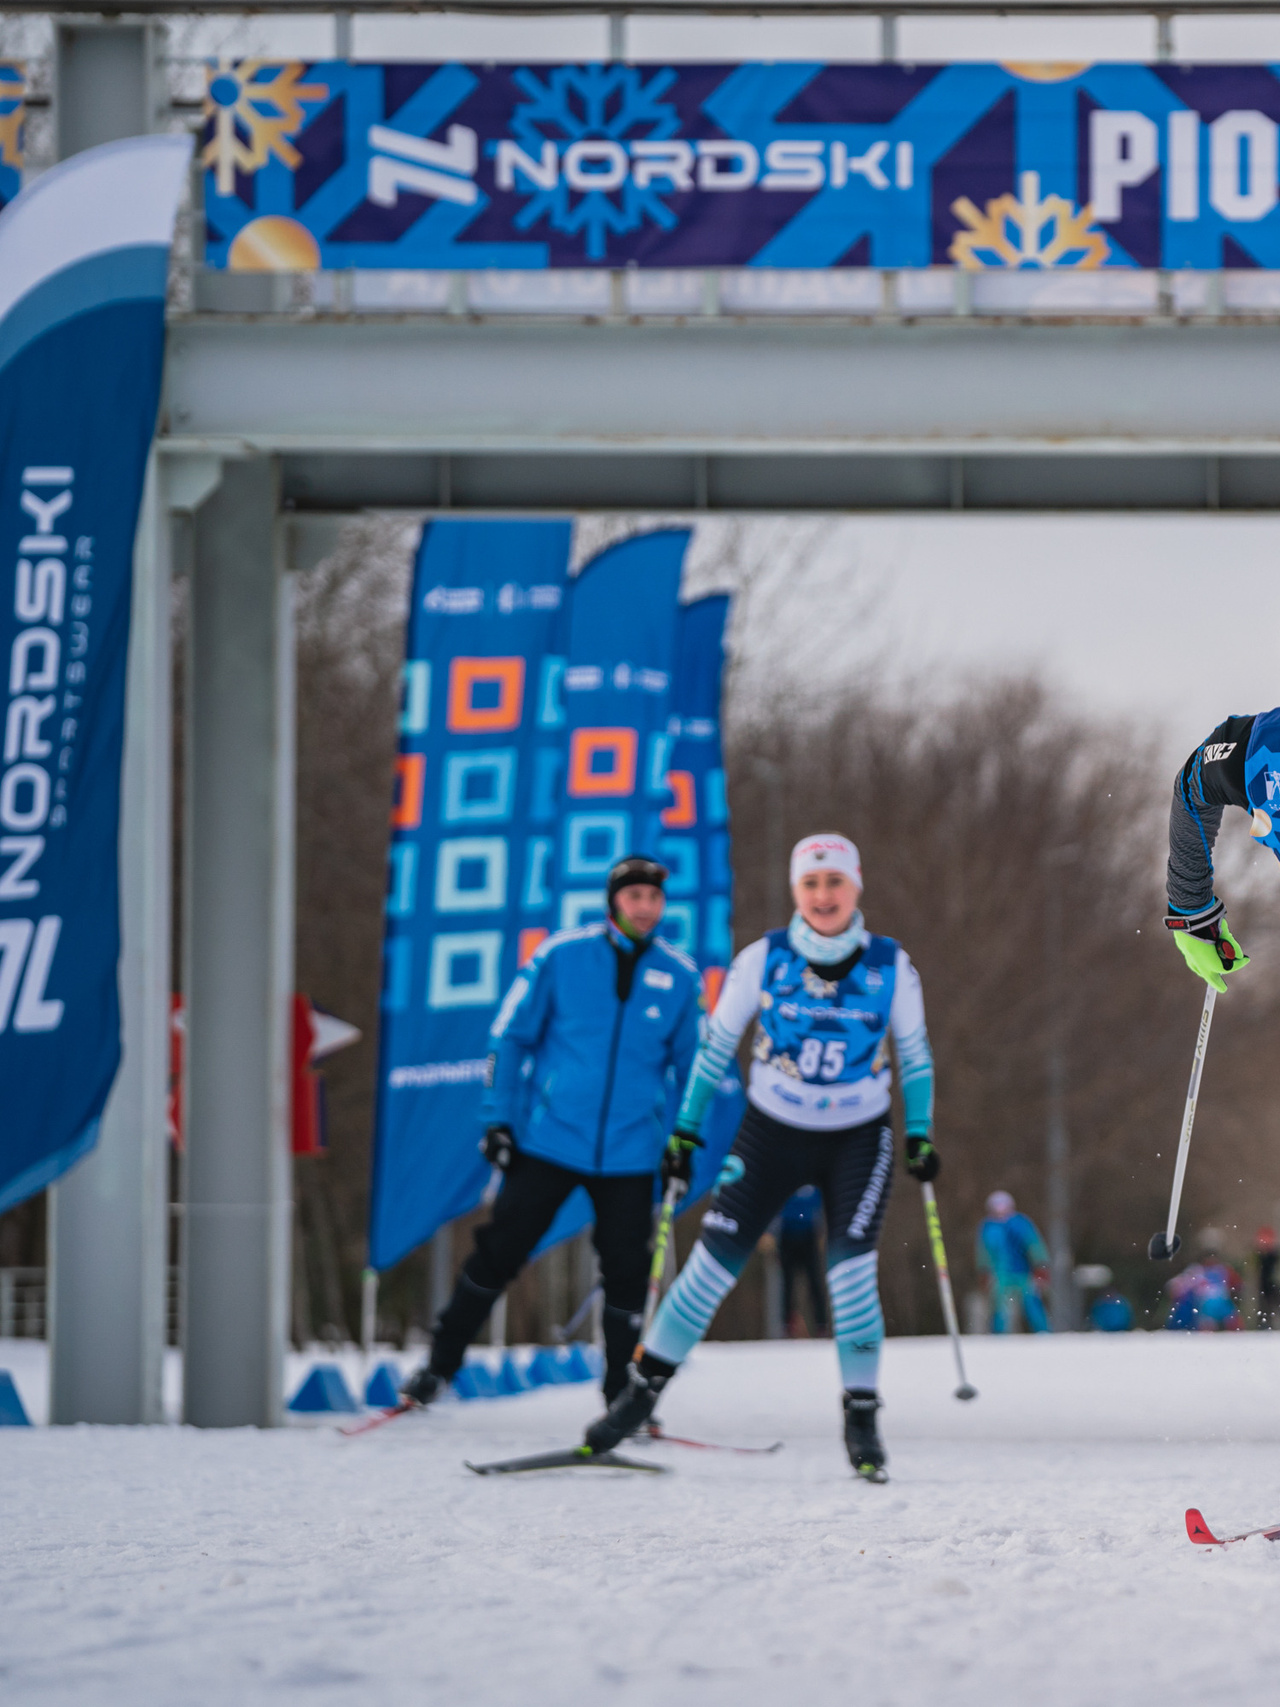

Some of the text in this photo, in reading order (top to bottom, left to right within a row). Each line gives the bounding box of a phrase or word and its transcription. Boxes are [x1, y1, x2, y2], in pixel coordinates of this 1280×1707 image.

[496, 140, 913, 192] NORDSKI
[0, 466, 75, 899] NORDSKI
[798, 1038, 848, 1080] 85
